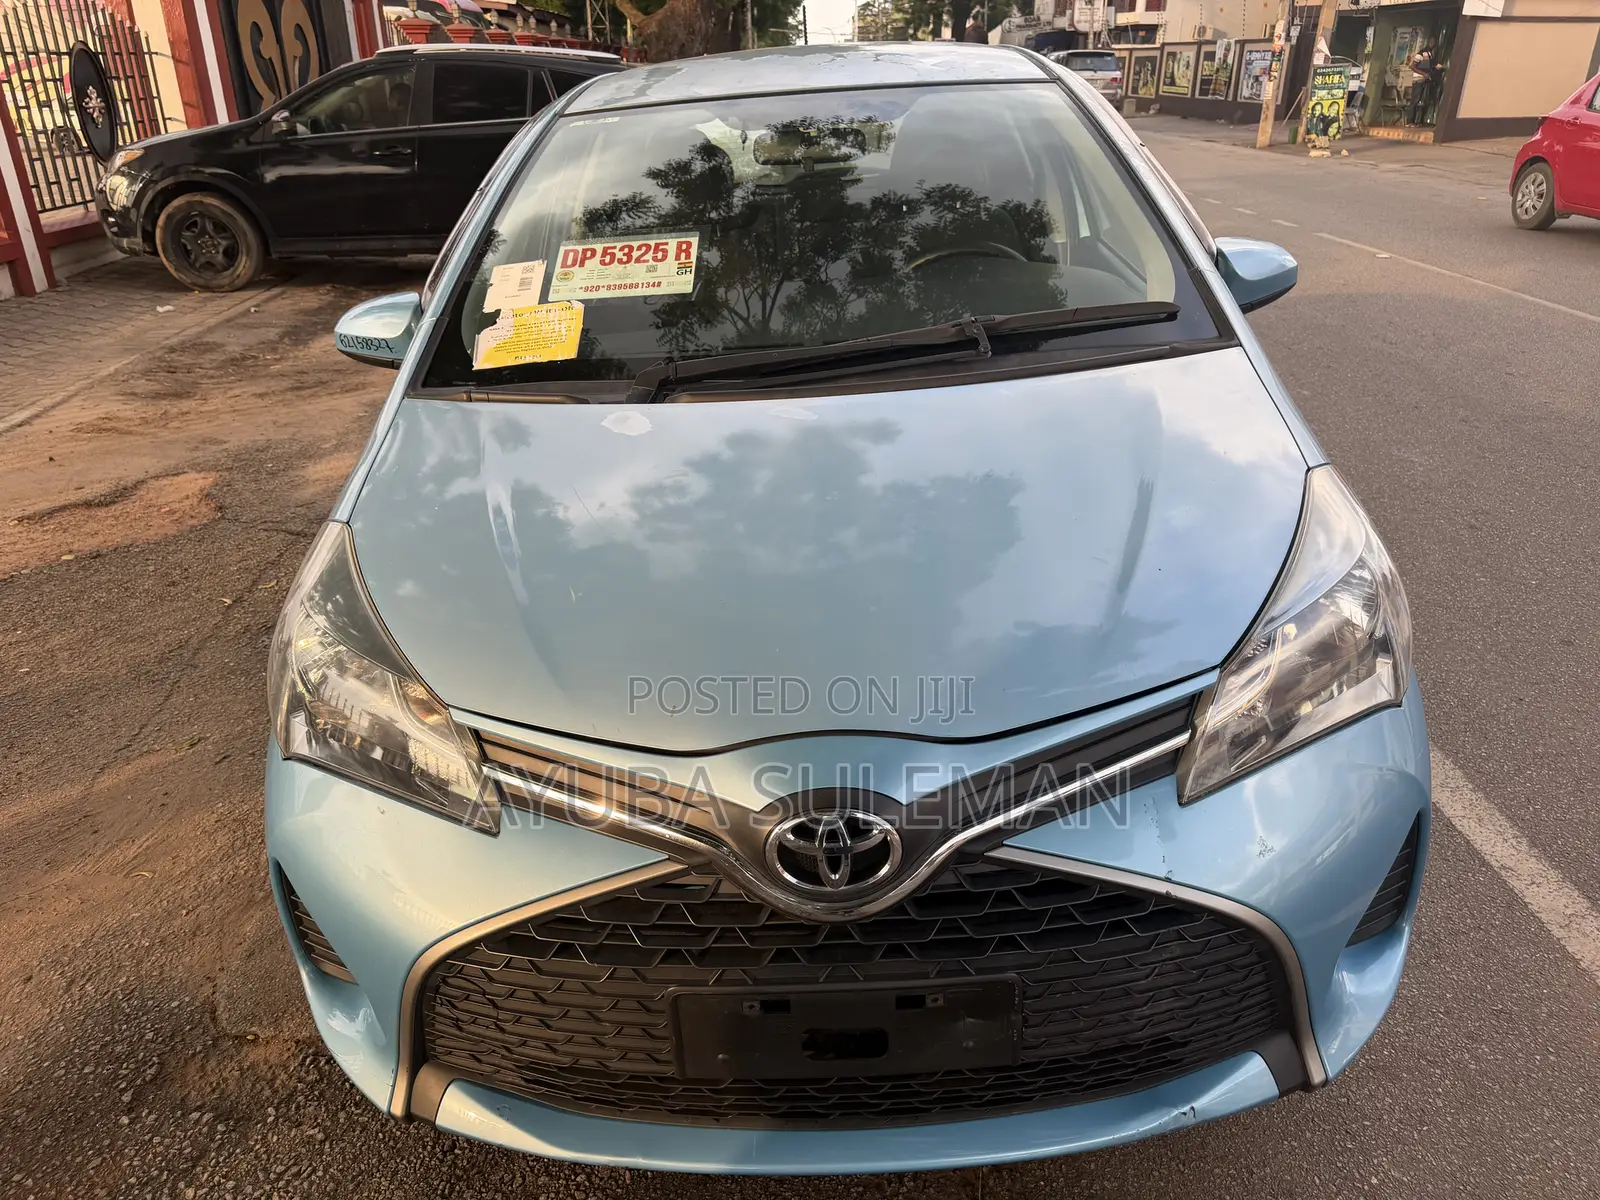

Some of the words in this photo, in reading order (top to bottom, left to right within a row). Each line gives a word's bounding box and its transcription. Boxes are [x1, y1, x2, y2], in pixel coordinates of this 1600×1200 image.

[559, 247, 597, 269] DP
[599, 241, 669, 267] 5325
[674, 240, 693, 262] R
[676, 268, 693, 276] GH
